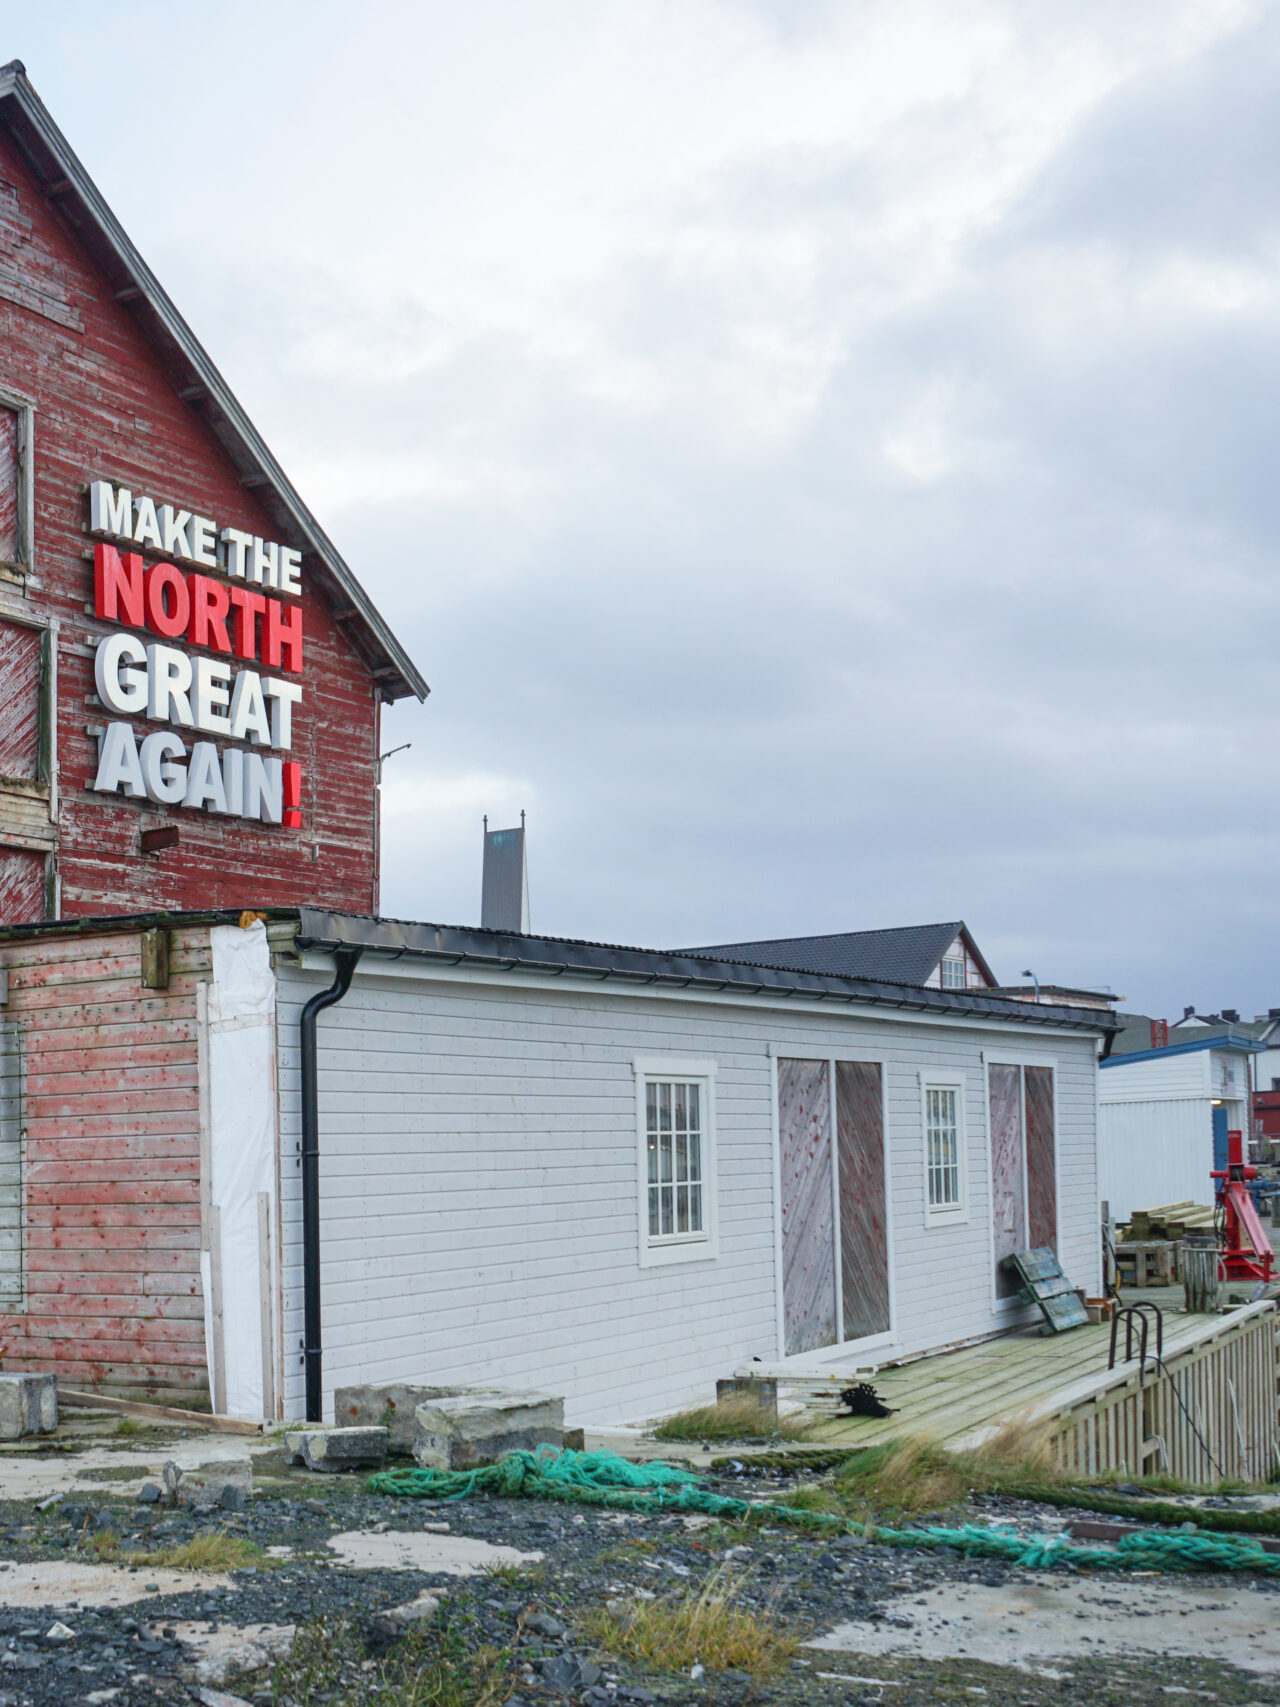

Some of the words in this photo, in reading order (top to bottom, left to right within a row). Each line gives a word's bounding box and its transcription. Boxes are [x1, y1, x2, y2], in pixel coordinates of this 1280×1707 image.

[91, 480, 217, 568] MAKE
[221, 527, 302, 596] THE
[94, 543, 303, 674] NORTH
[94, 633, 303, 751] GREAT
[93, 721, 302, 829] AGAIN!
